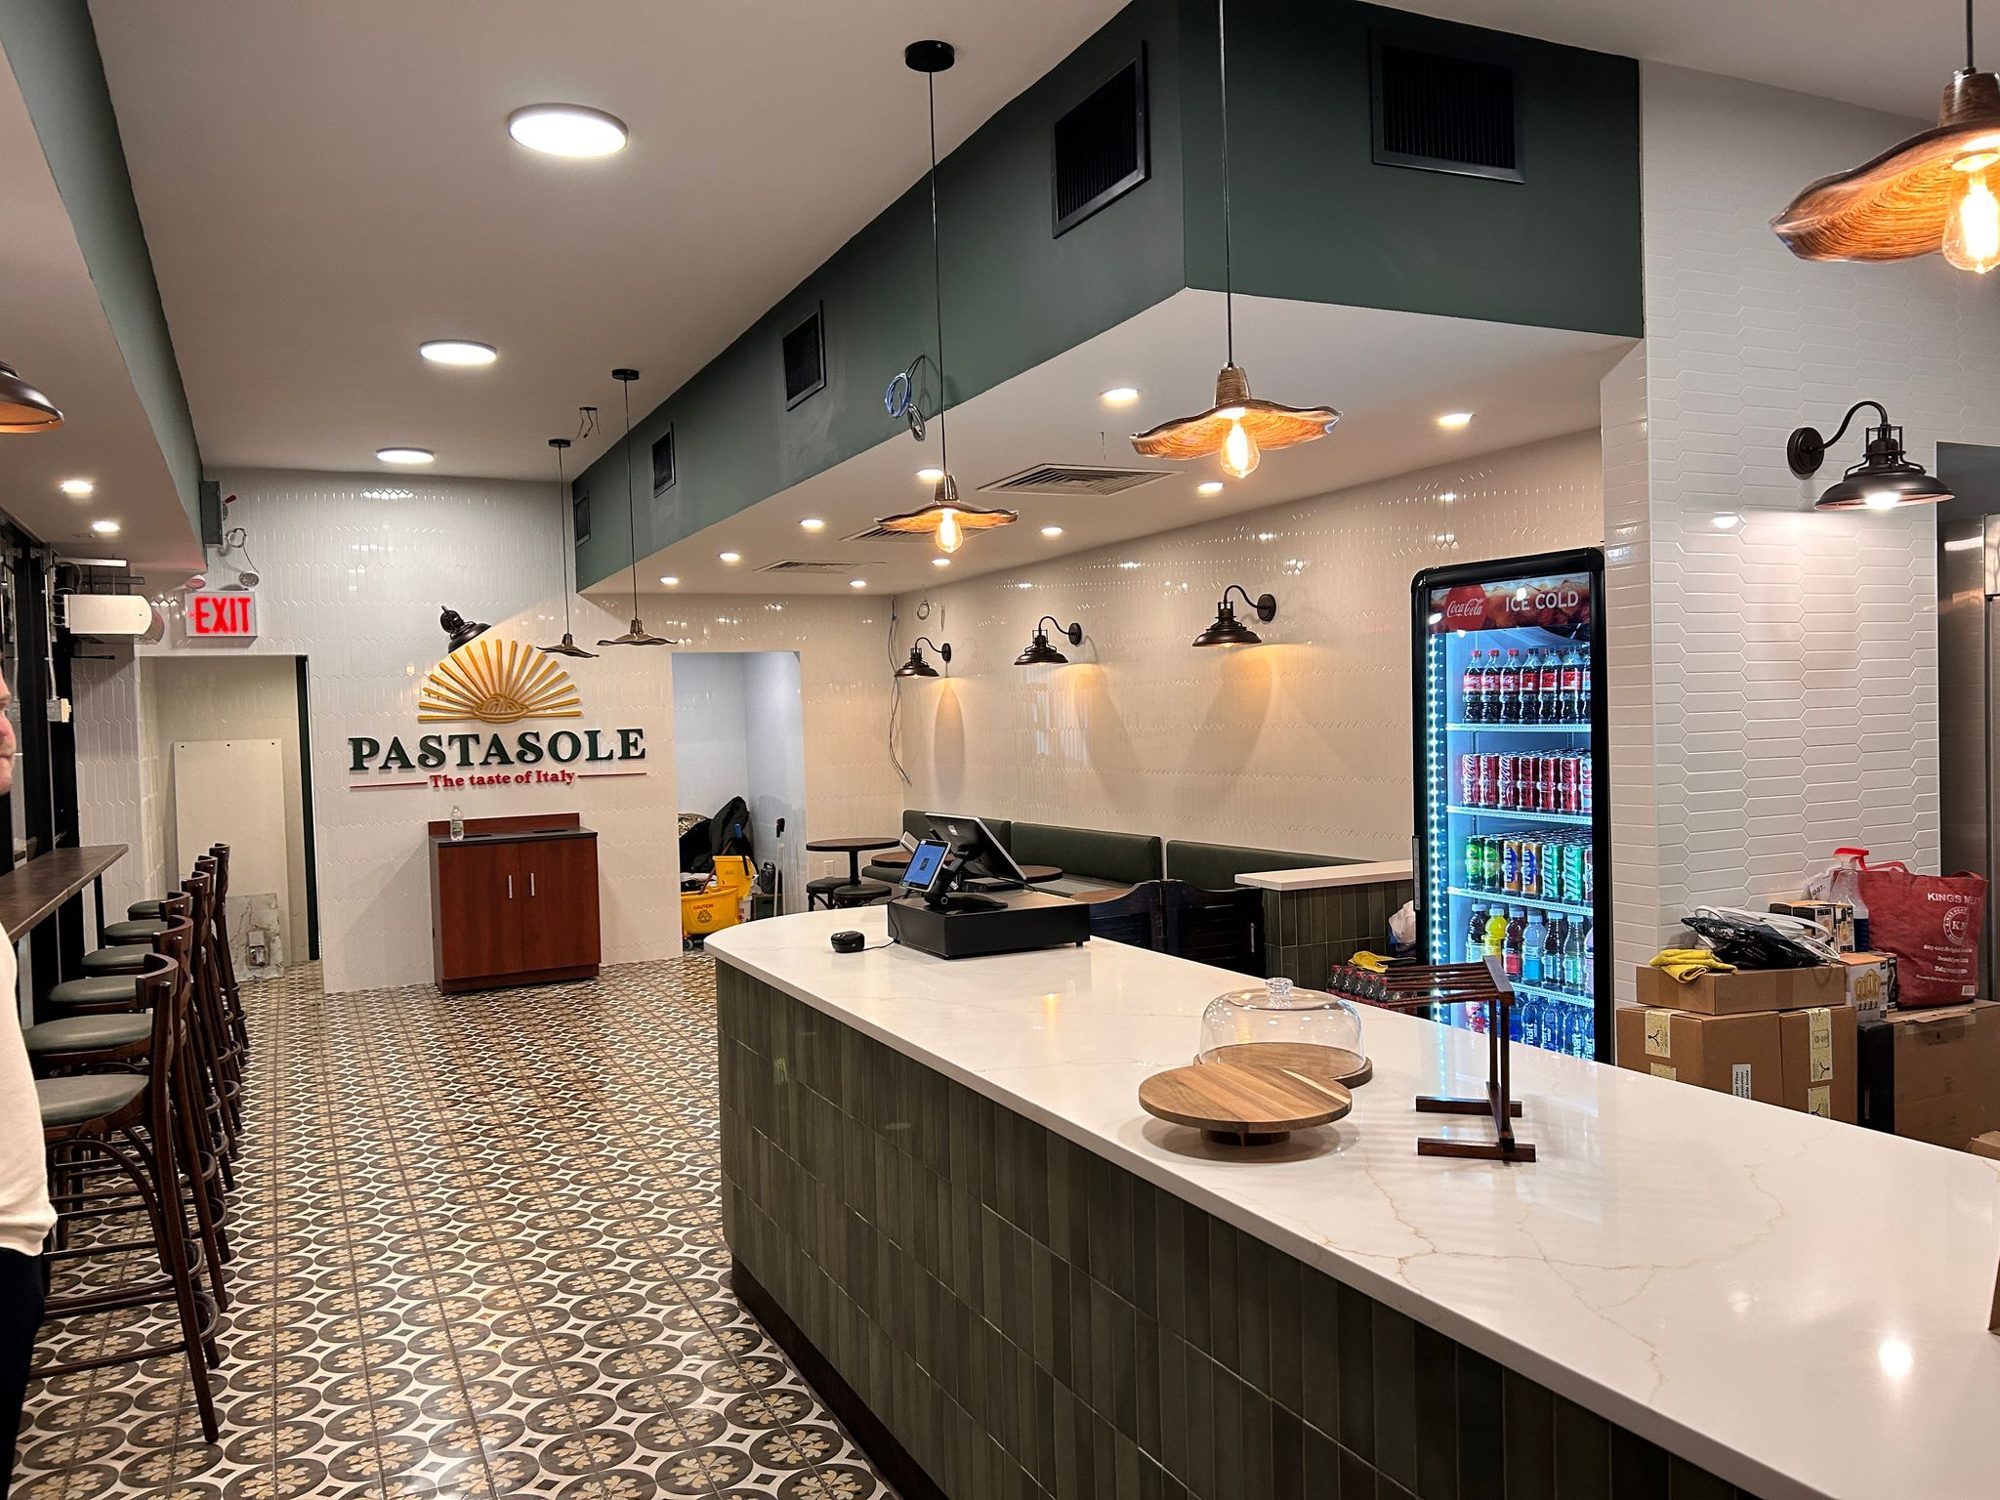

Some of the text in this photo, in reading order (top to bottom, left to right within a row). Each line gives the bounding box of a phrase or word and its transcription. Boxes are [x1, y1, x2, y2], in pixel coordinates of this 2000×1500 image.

[1506, 590, 1579, 612] ICE COLD
[195, 596, 251, 634] EXIT
[348, 729, 646, 770] PASTASOLE
[430, 769, 575, 788] The taste of Italy
[1927, 892, 1962, 903] KINGS
